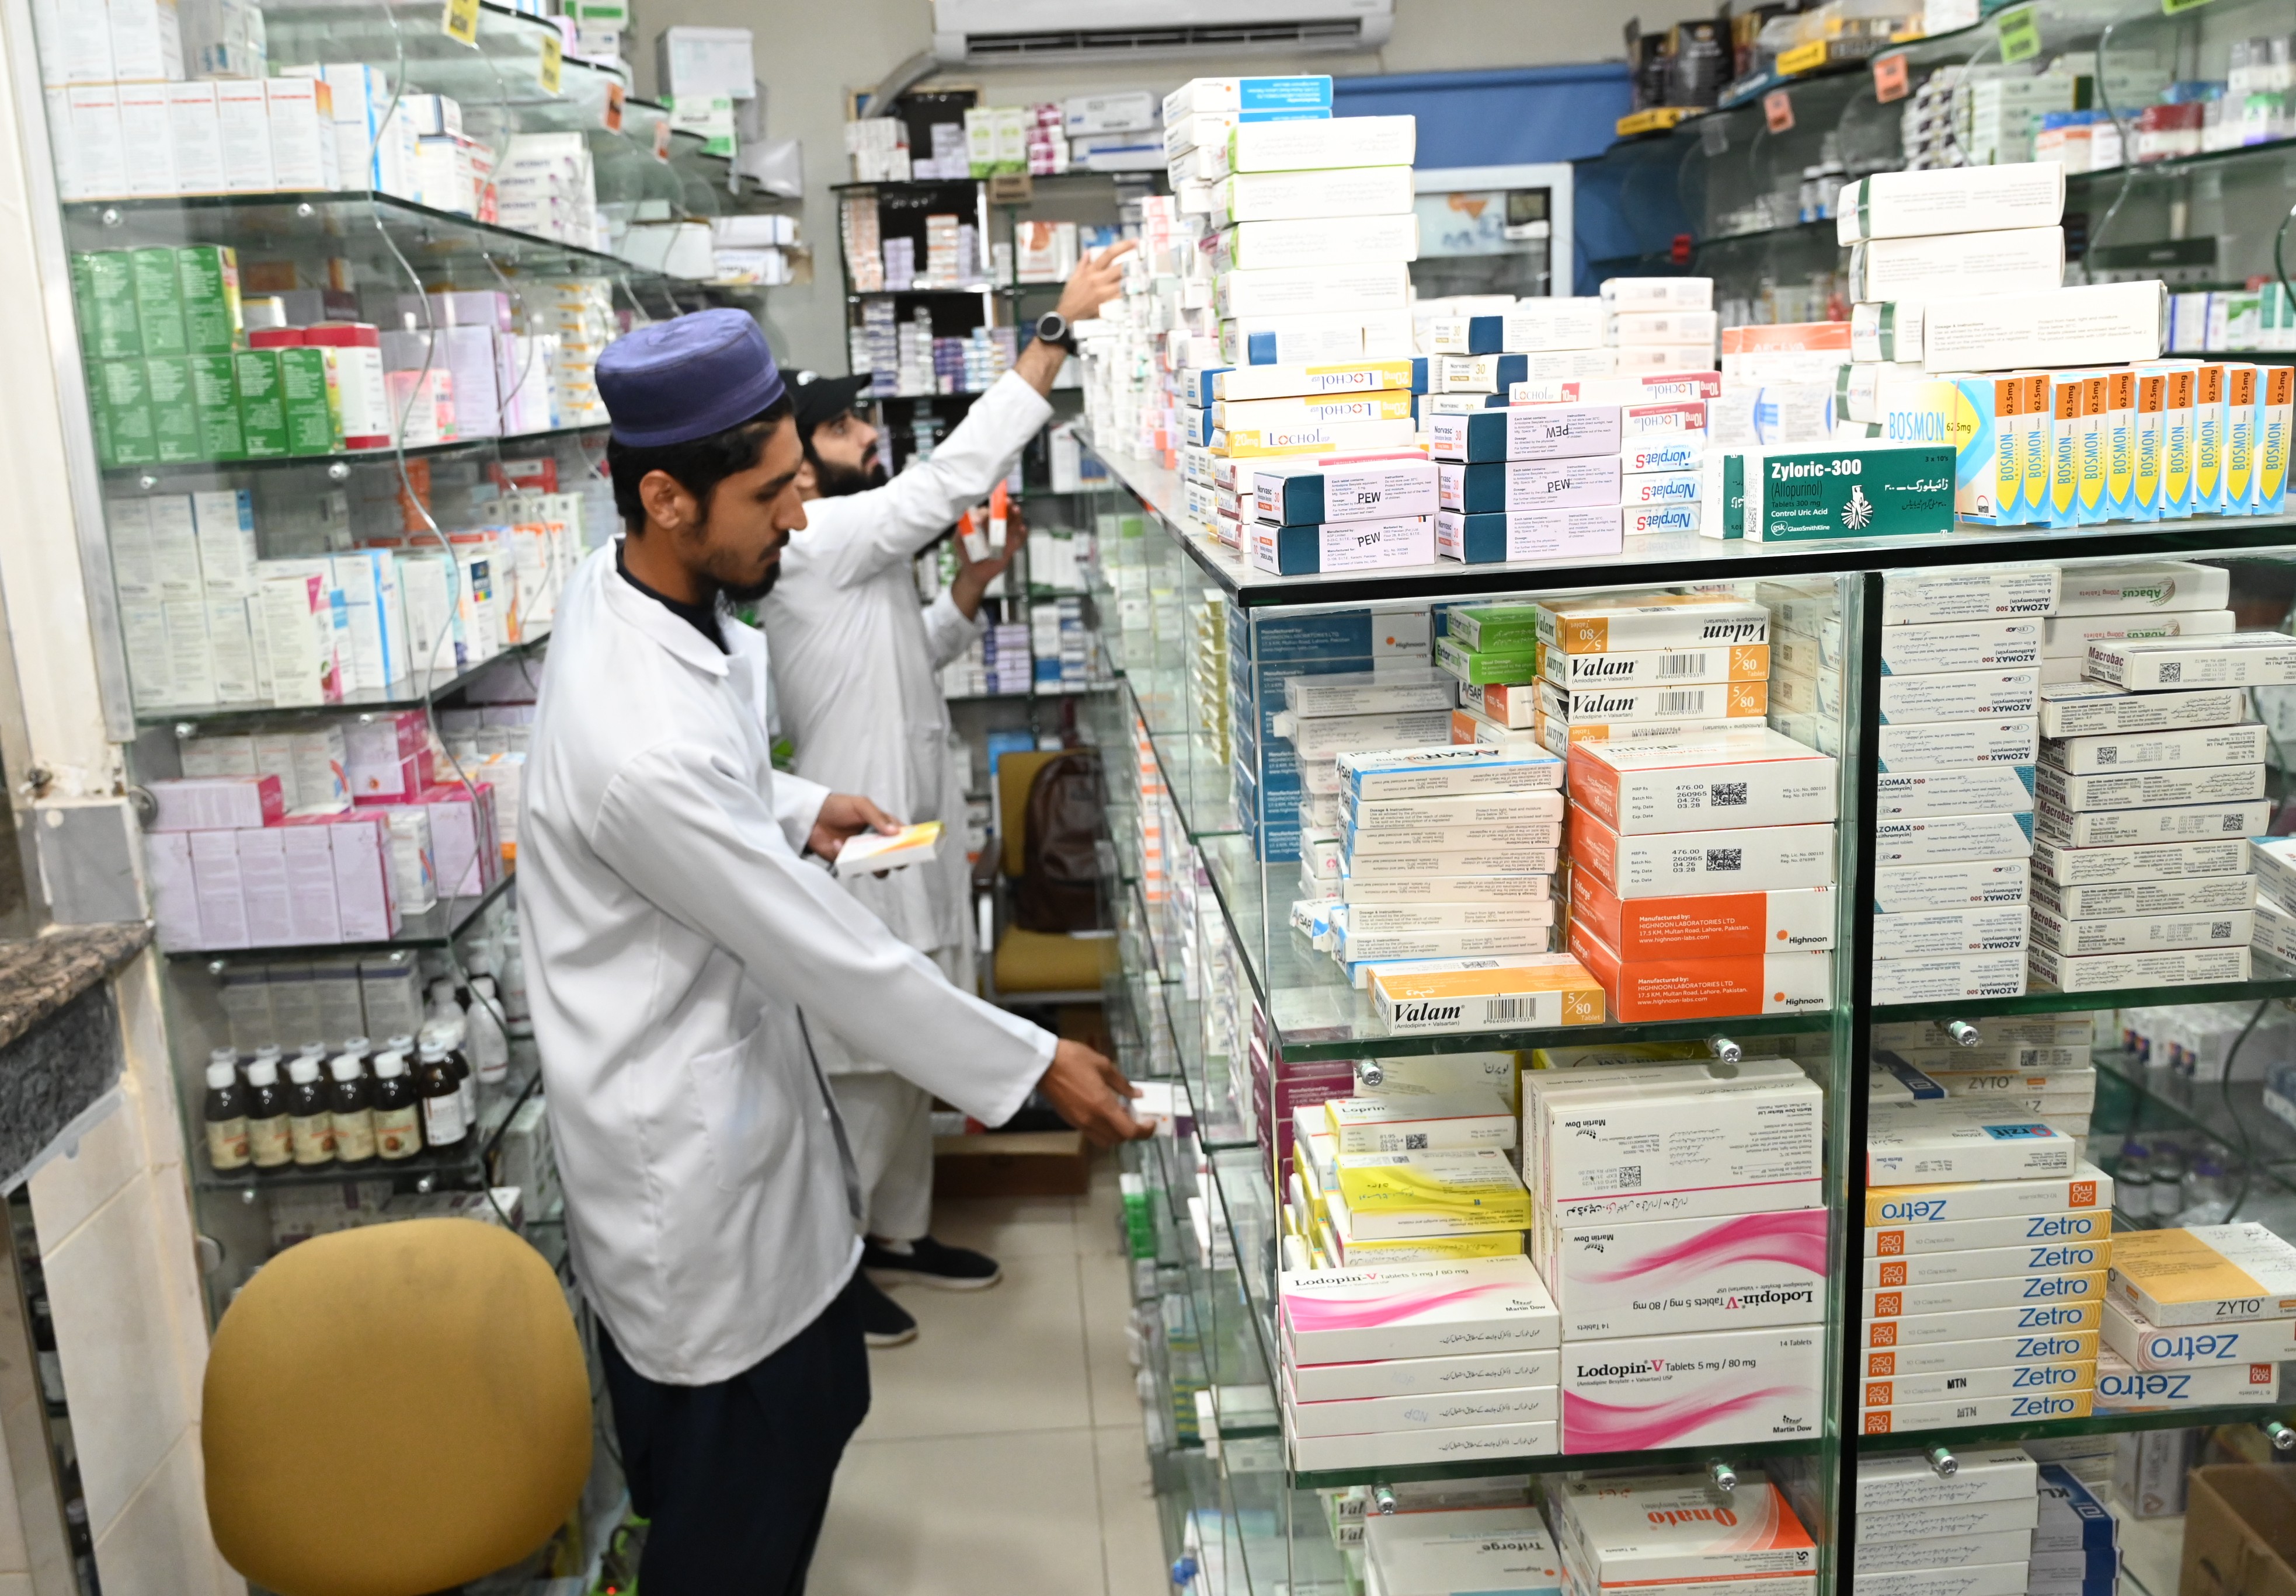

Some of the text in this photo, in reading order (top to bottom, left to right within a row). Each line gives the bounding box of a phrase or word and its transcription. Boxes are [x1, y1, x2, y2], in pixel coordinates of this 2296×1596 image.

[1384, 371, 1408, 384] 20mg
[1476, 364, 1485, 374] 30
[2120, 375, 2128, 407] 62.5mg
[2209, 370, 2217, 401] 62.5mg
[2278, 371, 2287, 403] 62.5mg
[2006, 382, 2015, 414] 62.5mg
[2067, 385, 2075, 417] 62.5mg
[1455, 431, 1462, 440] 30
[1546, 425, 1568, 438] PEW
[1889, 412, 1971, 441] BOSMON 625mg
[1234, 434, 1258, 446] 20mg
[2202, 421, 2214, 468] BOSMON
[2266, 423, 2281, 470] BOSMON
[2029, 431, 2041, 478] BOSMON
[2085, 433, 2097, 479] BOSMON
[2141, 430, 2155, 476] BOSMON
[1772, 459, 1862, 481] Zyloric-300
[1358, 492, 1381, 503] PEW
[1772, 480, 1822, 501] (Allopurinol)
[1773, 525, 1784, 533] gsk
[1358, 532, 1380, 547] PEW
[2123, 590, 2161, 598] Abacus
[2010, 604, 2050, 612] AZOMAX
[1536, 612, 1554, 637] Valam
[1703, 624, 1765, 643] Valam
[2088, 647, 2124, 667] Macrobac
[1572, 658, 1634, 677] Valam
[2088, 665, 2121, 682] 500mg Tablet
[1573, 694, 1634, 713] Valam
[2040, 801, 2074, 825] Macrobac
[1639, 934, 1709, 943] www.highnoon-labs.com
[1394, 1002, 1461, 1021] Valam
[1786, 998, 1823, 1006] Highnoon
[1968, 1076, 2009, 1089] ZYTO
[2072, 1191, 2092, 1202] 250
[2073, 1183, 2092, 1191] mg
[1881, 1200, 1947, 1221] Zetro
[2029, 1247, 2093, 1267] Zetro
[1380, 1271, 1409, 1280] Tablets
[1455, 1268, 1468, 1276] mg
[2216, 1299, 2260, 1316] ZYTO
[2018, 1308, 2082, 1327] Zetro
[1873, 1326, 1893, 1336] 250
[1874, 1336, 1893, 1344] mg
[1665, 1361, 1695, 1371] Tablets
[1706, 1362, 1719, 1371] mg
[1729, 1359, 1740, 1368] 80
[1742, 1359, 1756, 1368] mg
[1947, 1378, 1966, 1389] MTN
[2100, 1374, 2191, 1399] Zetro
[2010, 1397, 2074, 1416] Zetro
[1868, 1415, 1888, 1426] 250
[1647, 1507, 1738, 1527] Onato
[1482, 1542, 1544, 1552] Triforge
